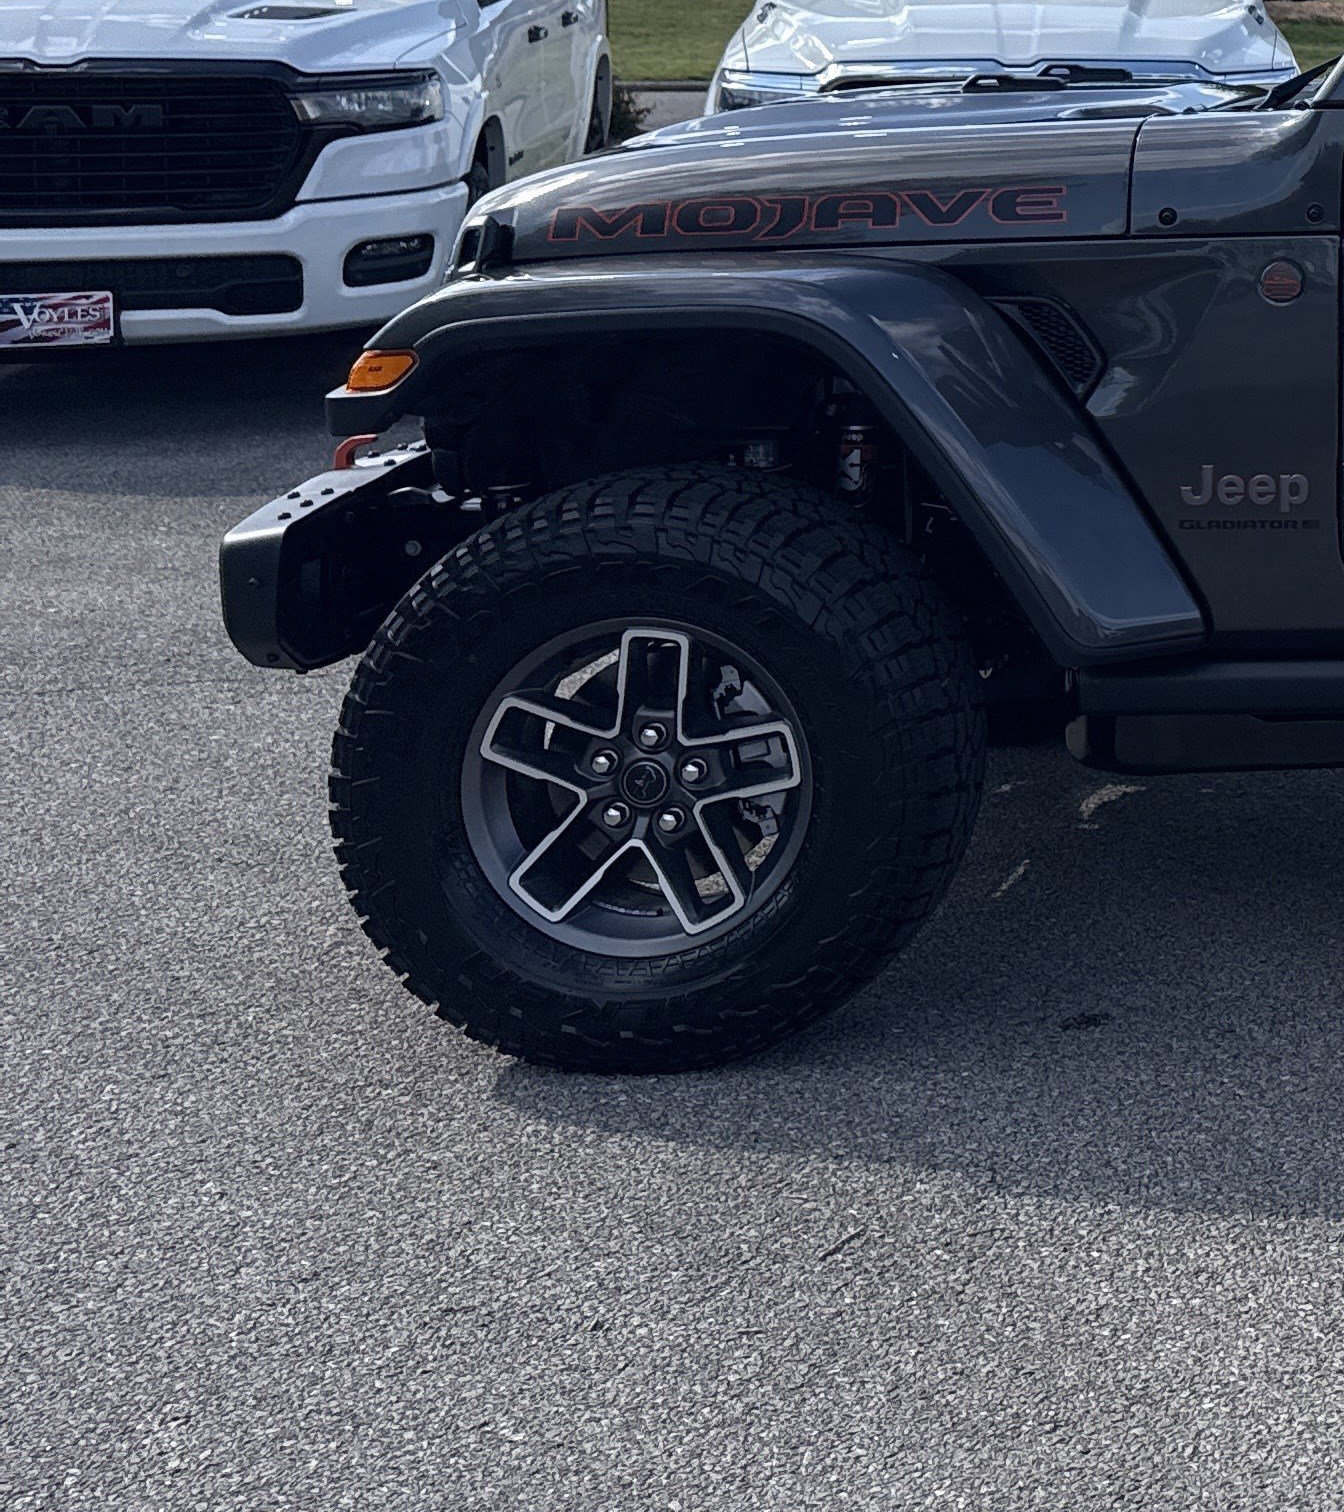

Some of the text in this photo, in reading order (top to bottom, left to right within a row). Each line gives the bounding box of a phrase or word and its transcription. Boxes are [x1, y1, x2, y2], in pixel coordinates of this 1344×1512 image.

[0, 104, 163, 128] AM
[547, 186, 1068, 241] MOJAVE
[11, 301, 101, 329] VOYLES
[1180, 464, 1310, 513] Jeep
[1179, 519, 1299, 530] GLADIATOR
